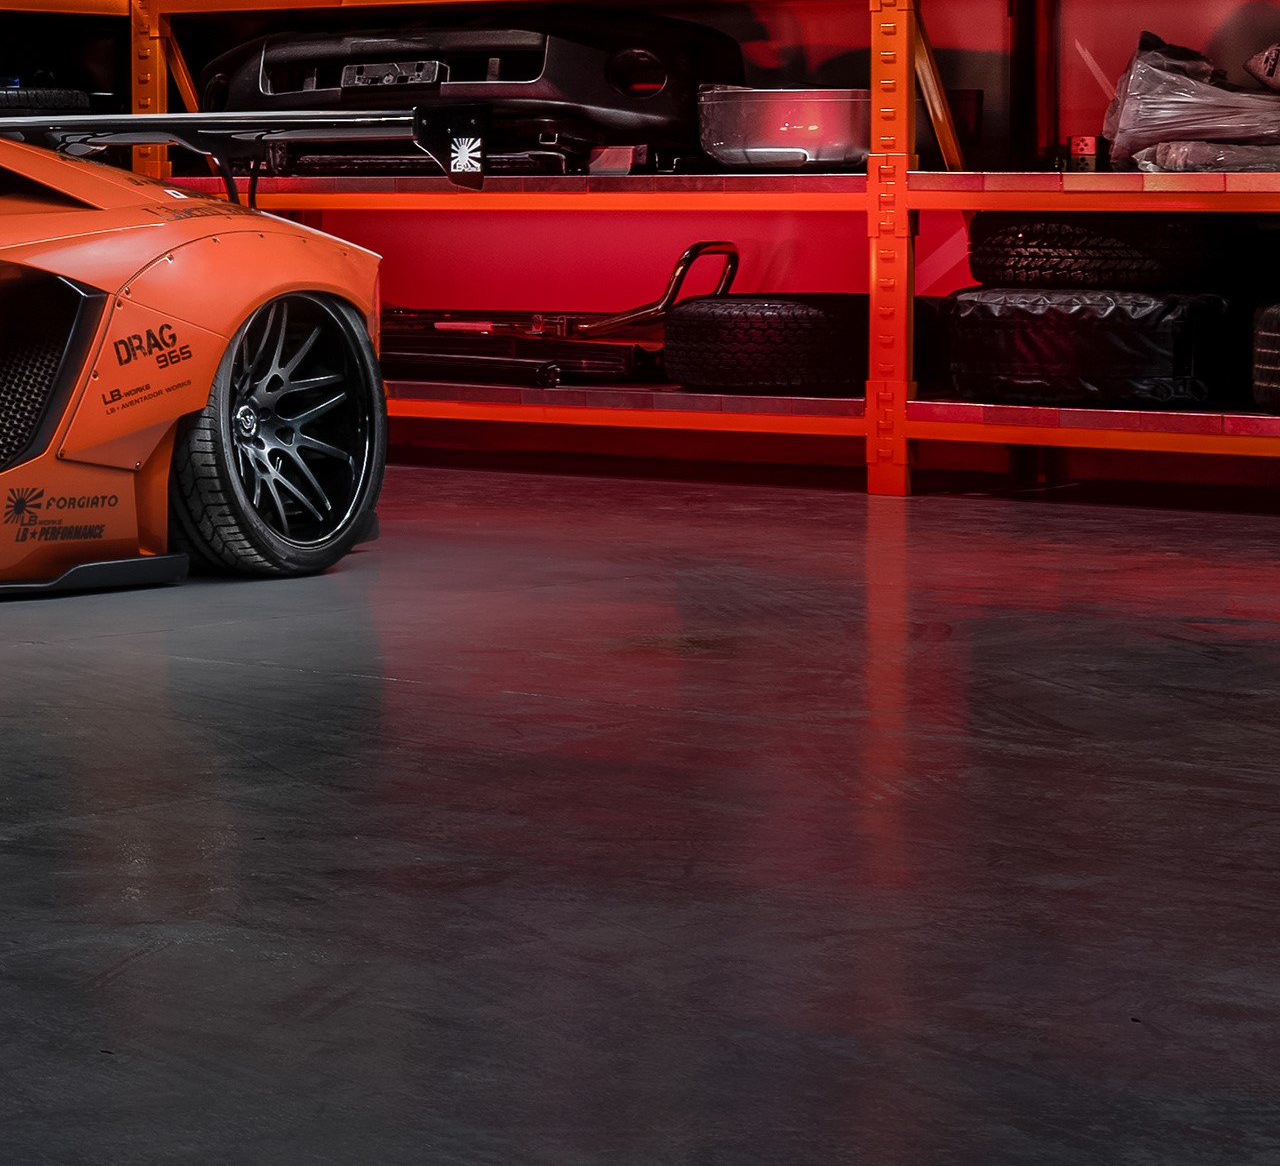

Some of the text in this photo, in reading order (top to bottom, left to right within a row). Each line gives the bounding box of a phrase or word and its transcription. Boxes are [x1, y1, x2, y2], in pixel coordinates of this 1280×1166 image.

[113, 323, 177, 366] DRAG
[155, 344, 192, 369] 965
[106, 379, 192, 415] LB AVENTADOR WORKS
[46, 494, 119, 510] FORGIATO
[15, 524, 106, 542] LB PERFORMANCE
